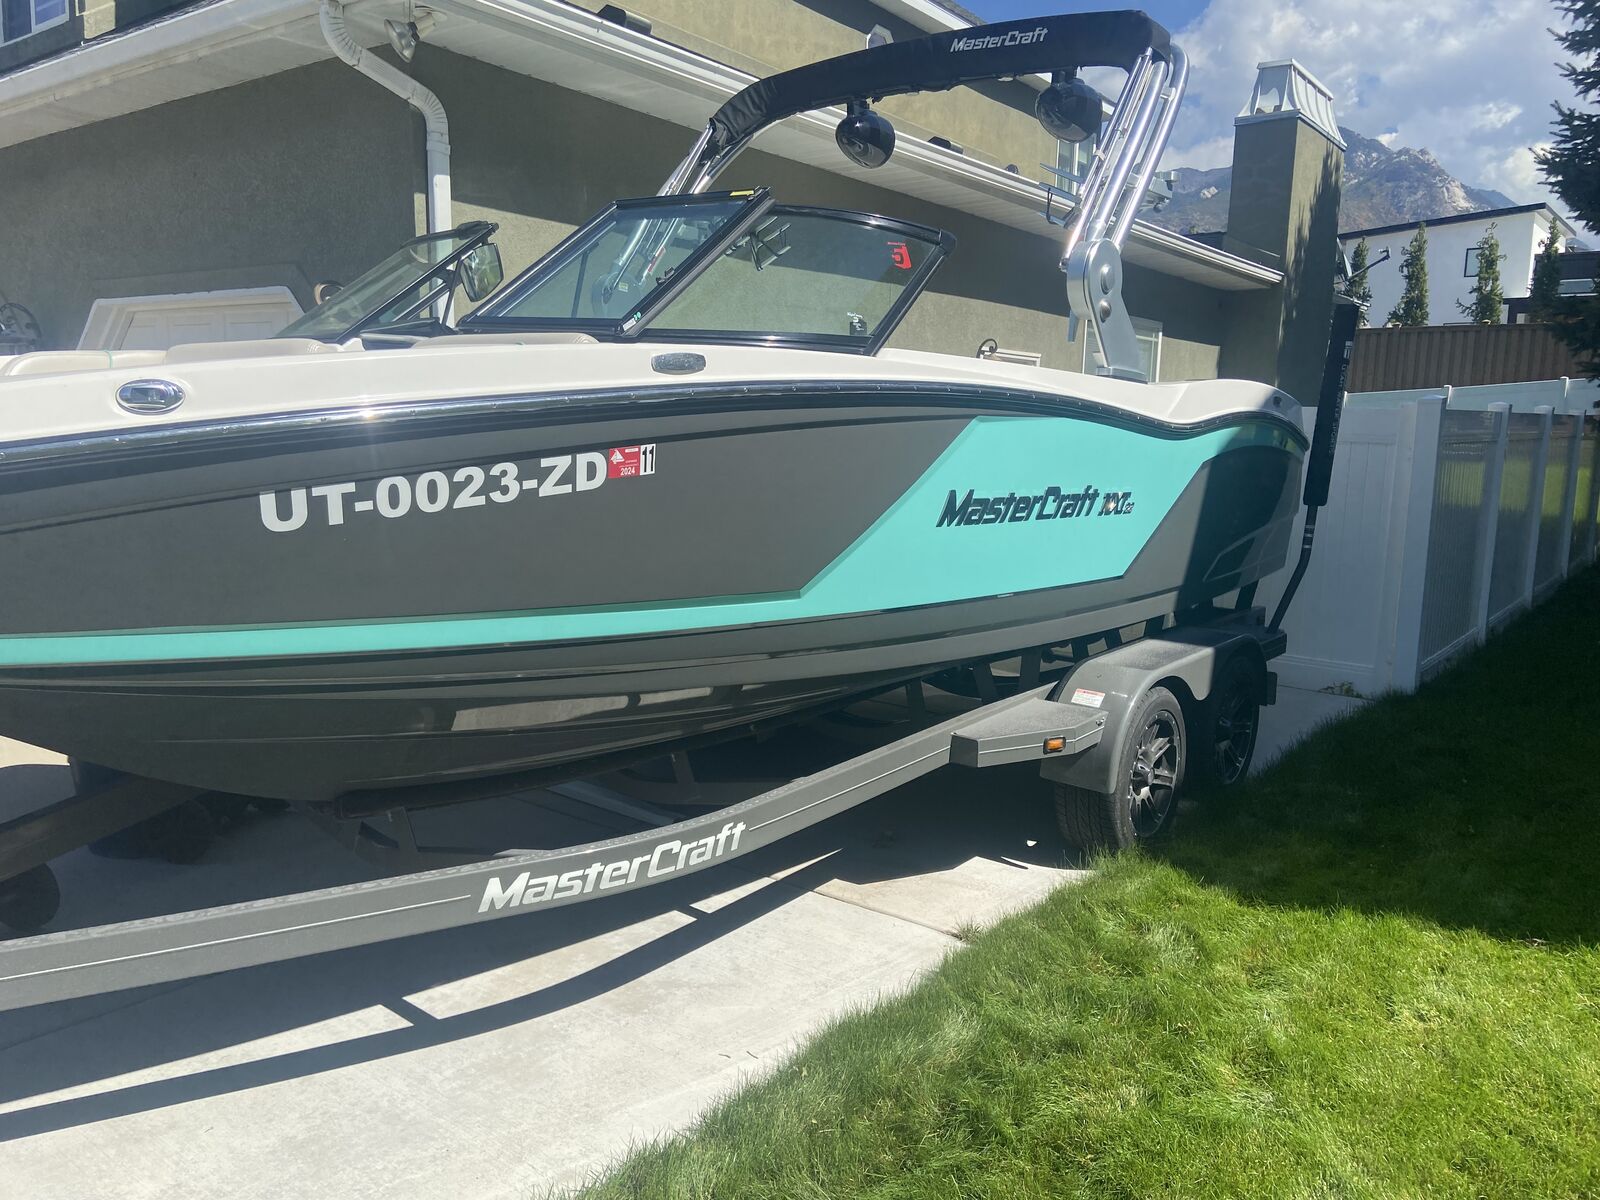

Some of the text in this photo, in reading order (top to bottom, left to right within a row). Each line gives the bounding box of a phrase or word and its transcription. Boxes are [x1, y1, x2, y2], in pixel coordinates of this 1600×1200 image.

[950, 27, 1049, 52] MasterCraft
[620, 466, 636, 476] 2024
[642, 445, 655, 473] 11
[259, 451, 608, 533] UT-0023-ZD
[936, 485, 1100, 528] MasterCraft
[478, 821, 747, 913] MasterCraft
